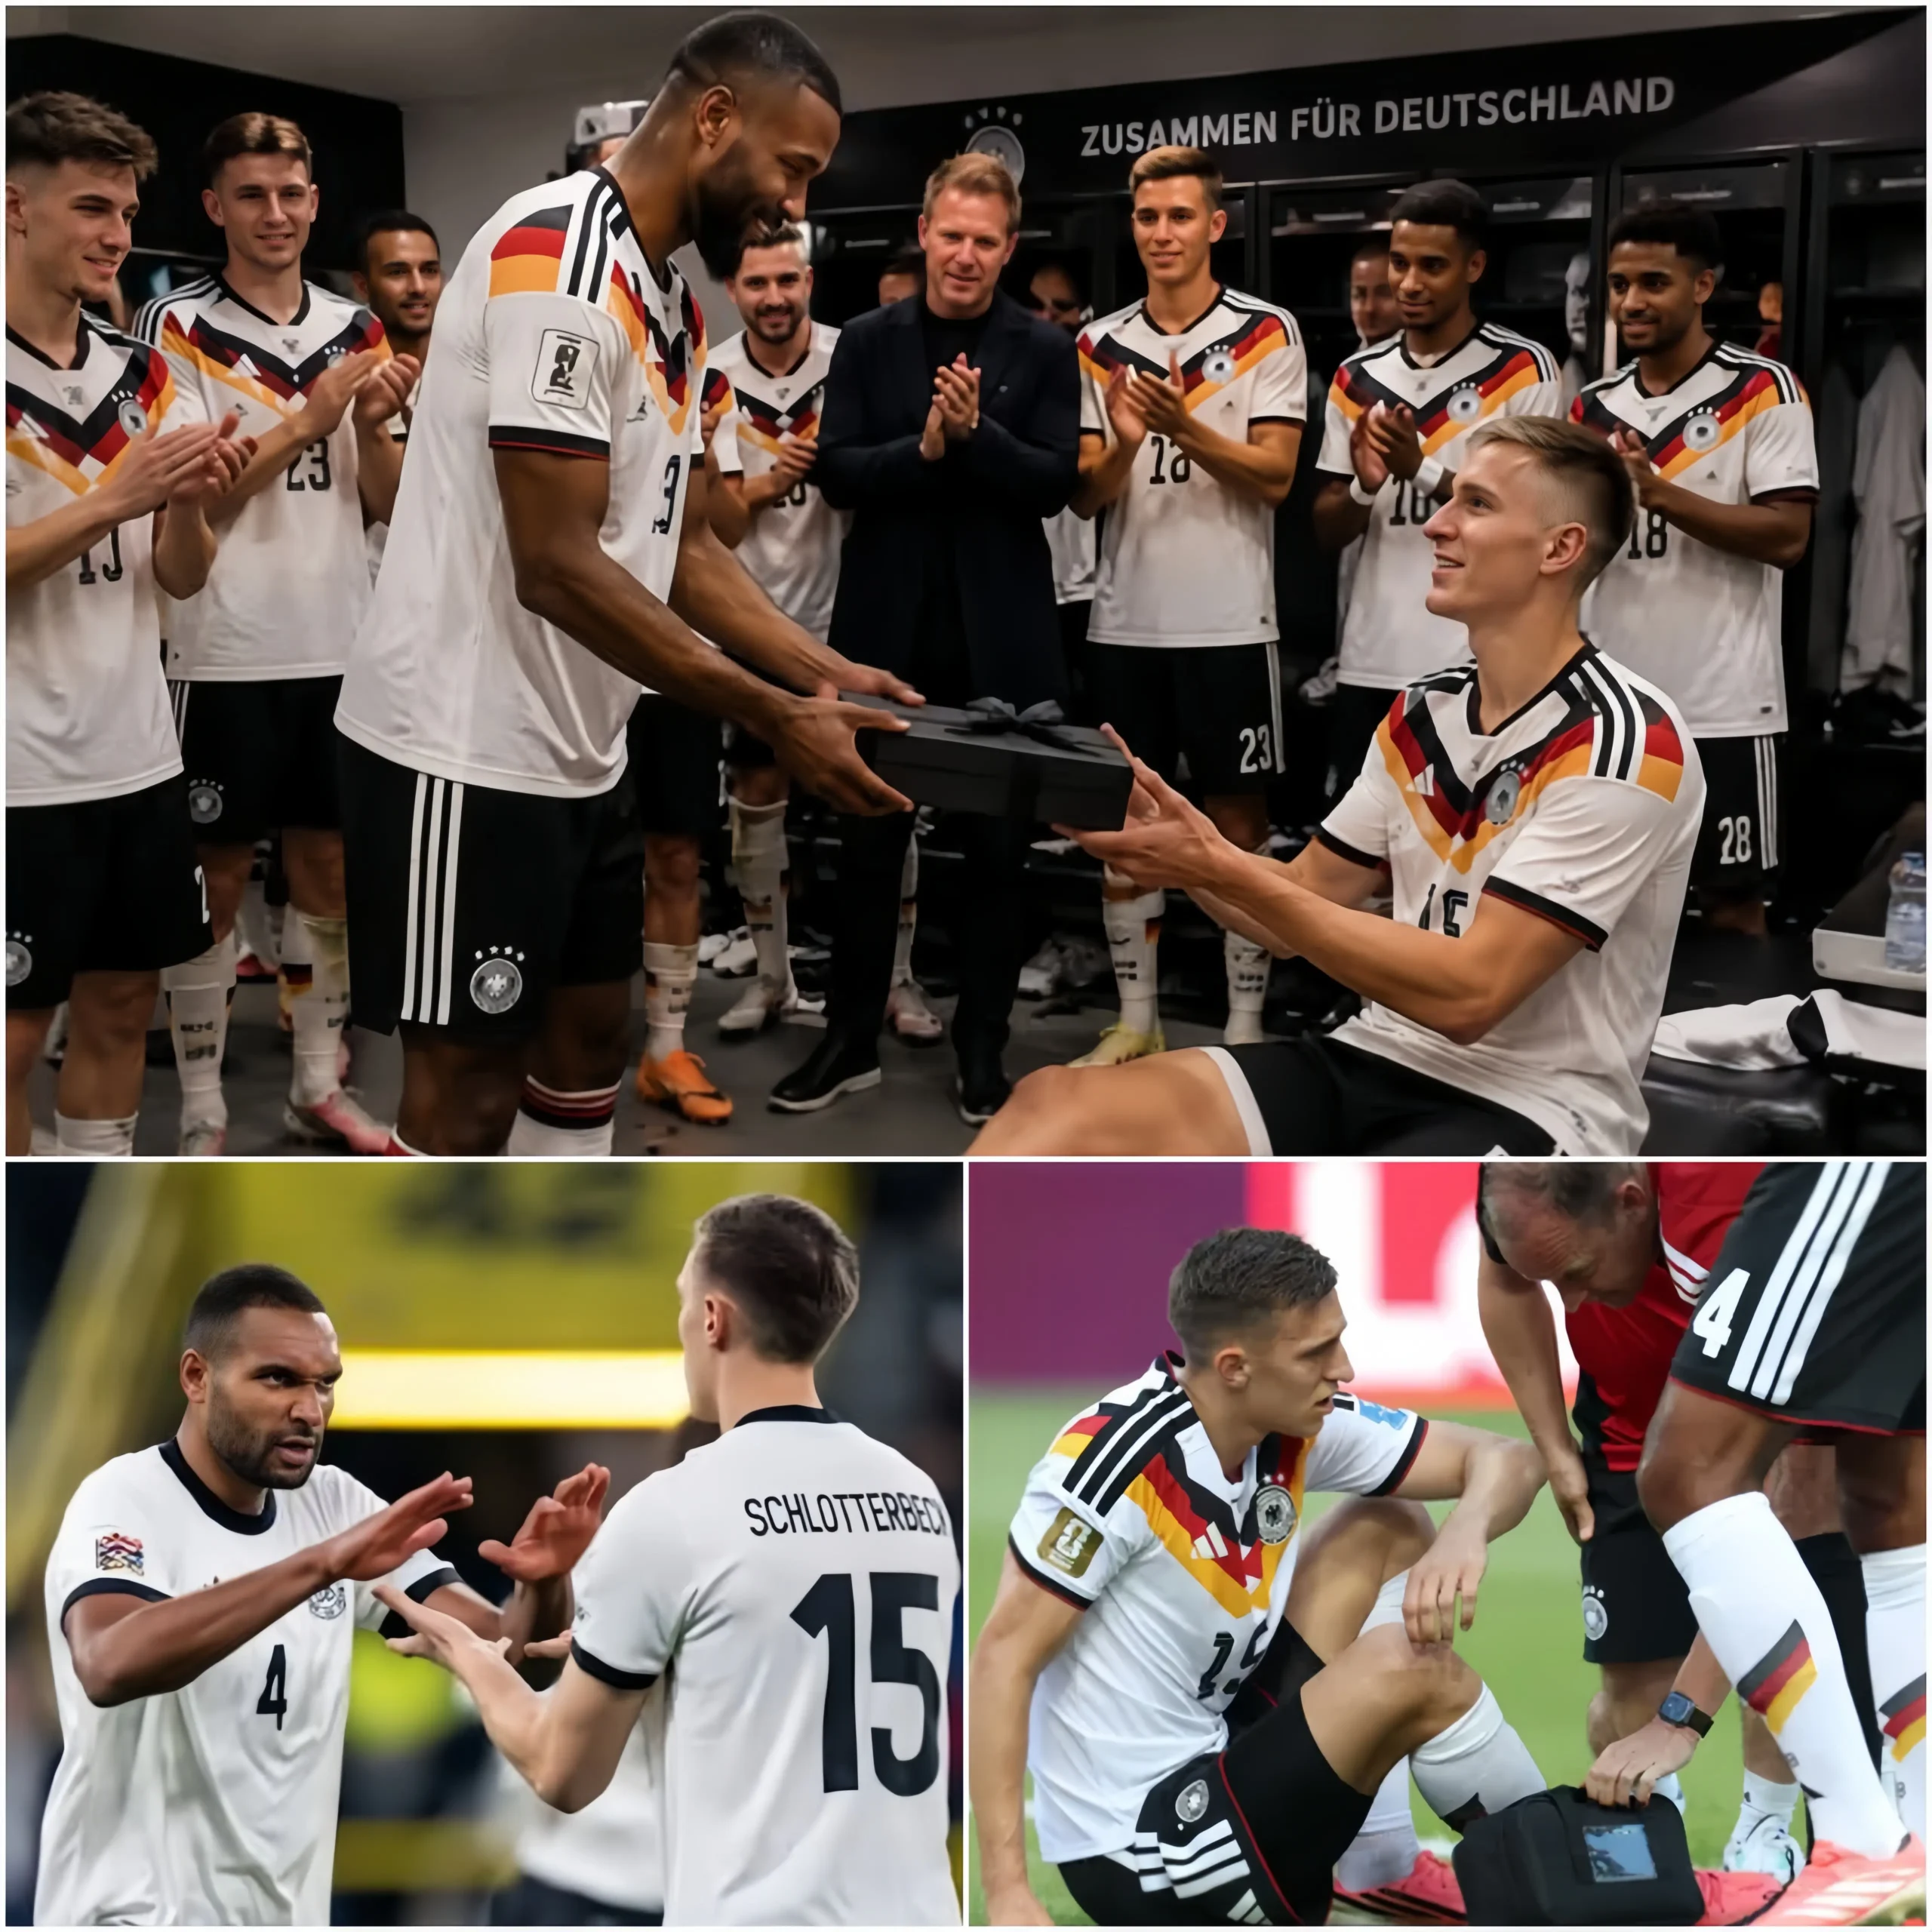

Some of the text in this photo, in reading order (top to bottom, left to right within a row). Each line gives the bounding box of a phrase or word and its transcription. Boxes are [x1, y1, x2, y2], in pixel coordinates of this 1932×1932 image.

[1081, 77, 1675, 157] ZUSAMMEN FÜR DEUTSCHLAND
[1239, 724, 1272, 774] 23
[1718, 816, 1752, 865] 28
[1693, 1268, 1751, 1358] 4
[256, 1644, 287, 1731] 4
[789, 1572, 942, 1798] 15
